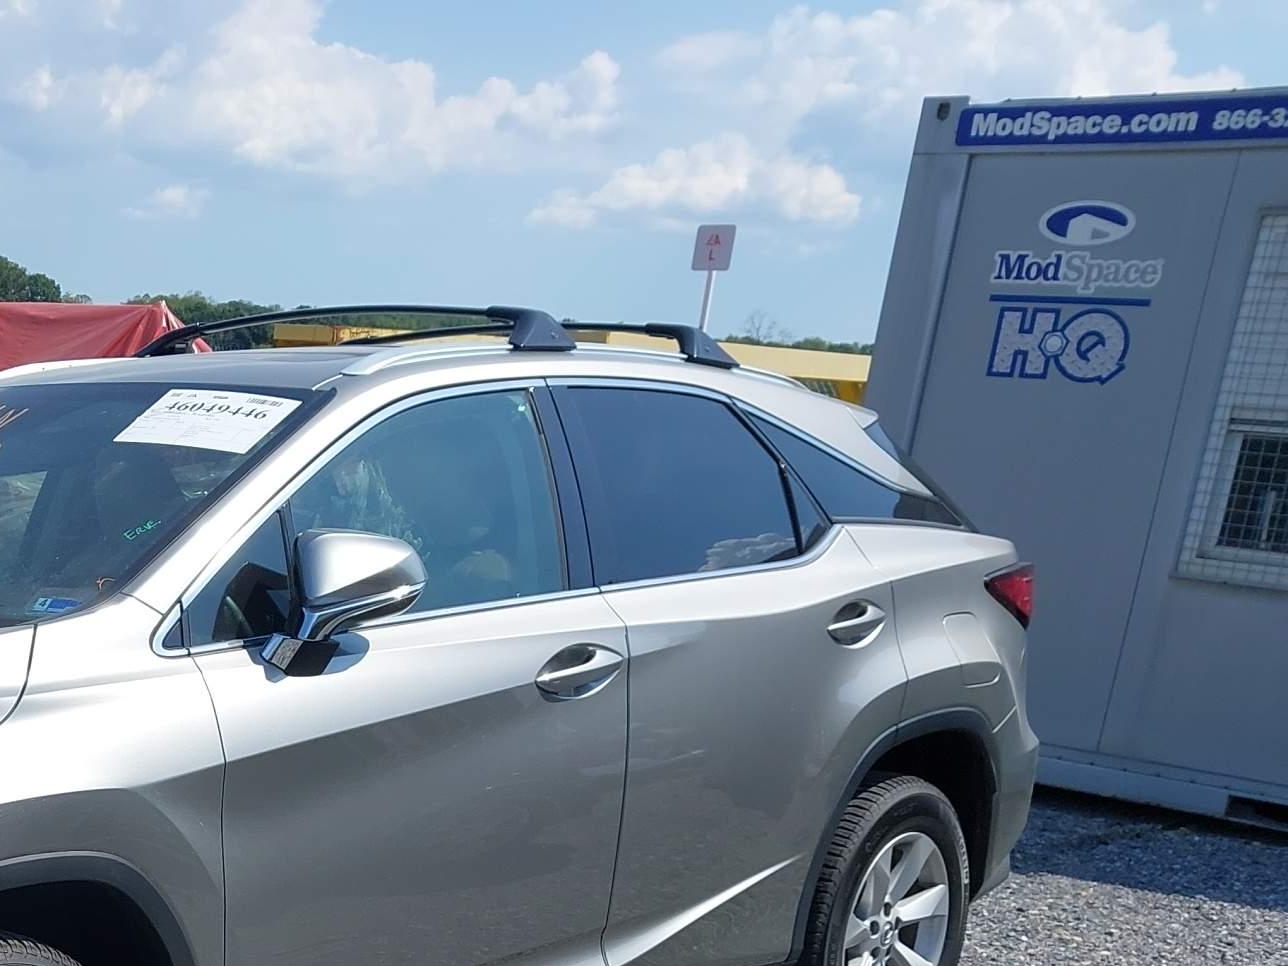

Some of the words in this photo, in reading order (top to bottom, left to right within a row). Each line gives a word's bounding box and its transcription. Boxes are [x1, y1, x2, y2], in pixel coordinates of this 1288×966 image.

[970, 109, 1198, 138] ModSpace.com
[1212, 107, 1288, 131] 866-3
[993, 252, 1160, 292] ModSpace
[165, 400, 269, 420] 46049446
